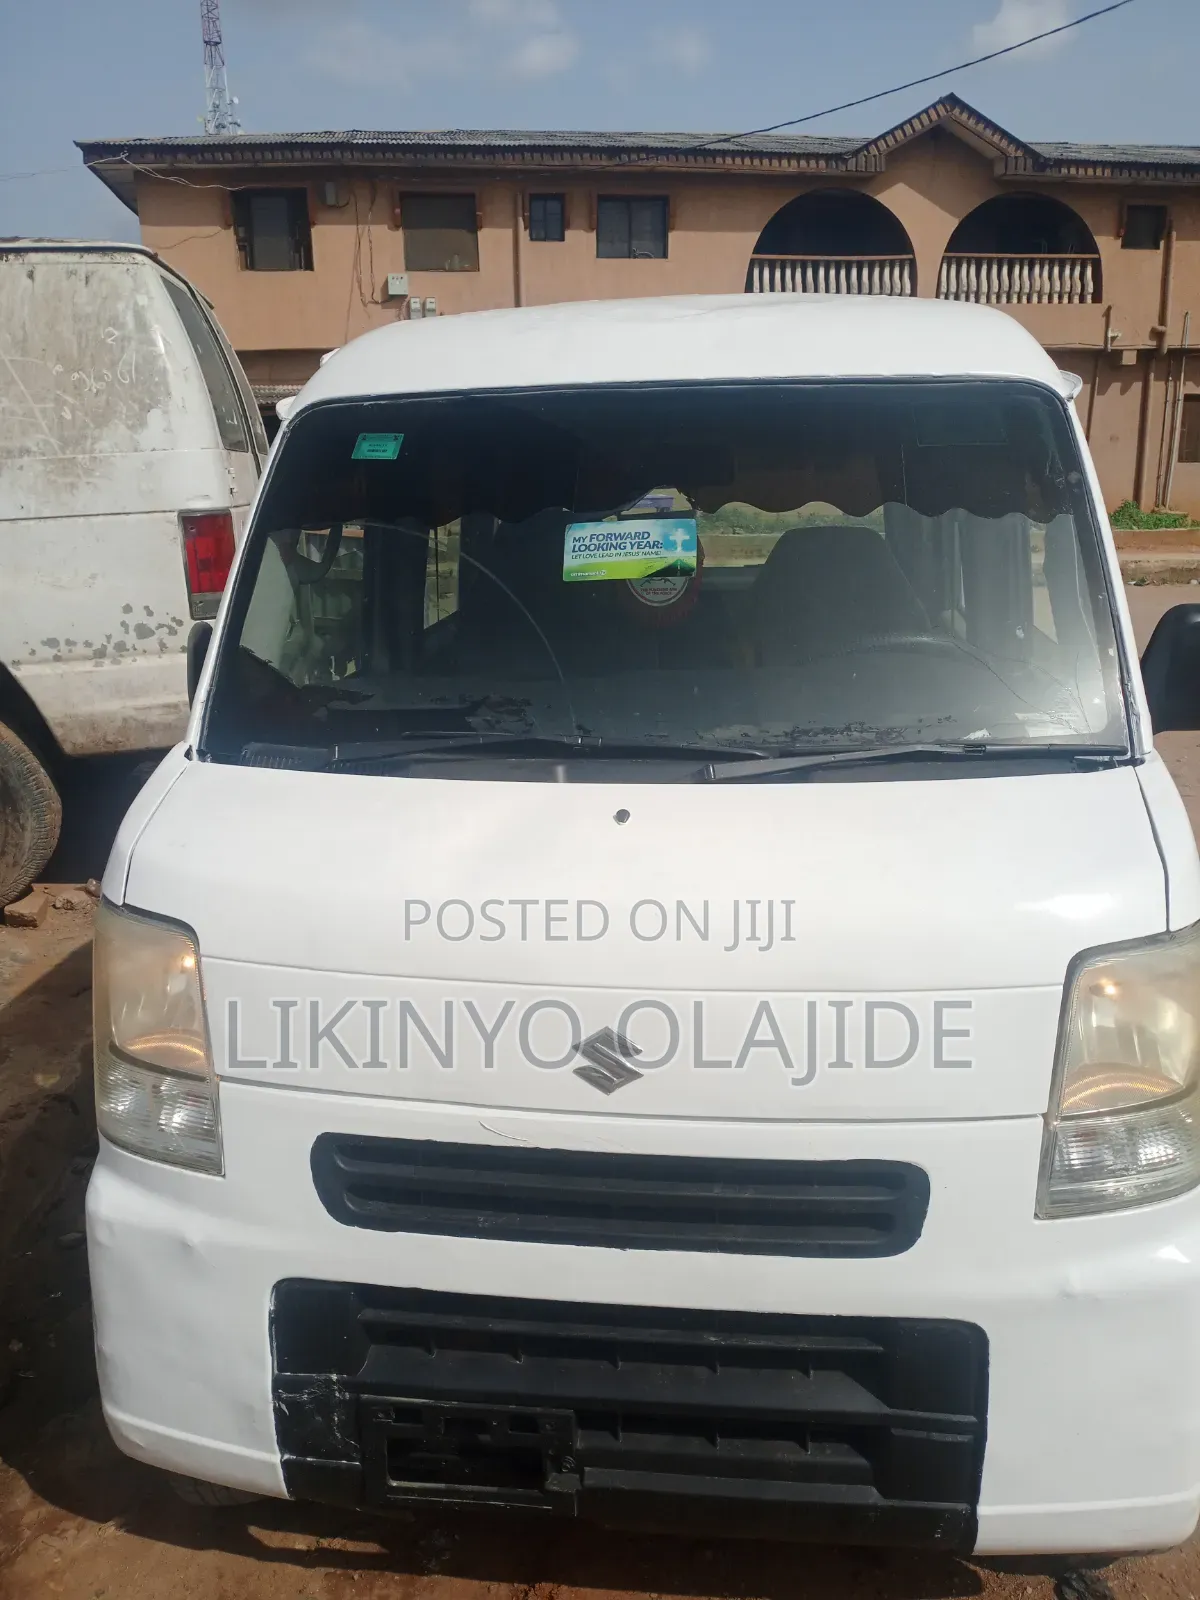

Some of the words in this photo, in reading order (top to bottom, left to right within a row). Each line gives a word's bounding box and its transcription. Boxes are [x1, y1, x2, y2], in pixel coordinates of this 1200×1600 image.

[572, 536, 588, 544] MY
[589, 531, 650, 542] FORWARD
[572, 542, 627, 553] LOOKING
[629, 540, 664, 550] YEAR:
